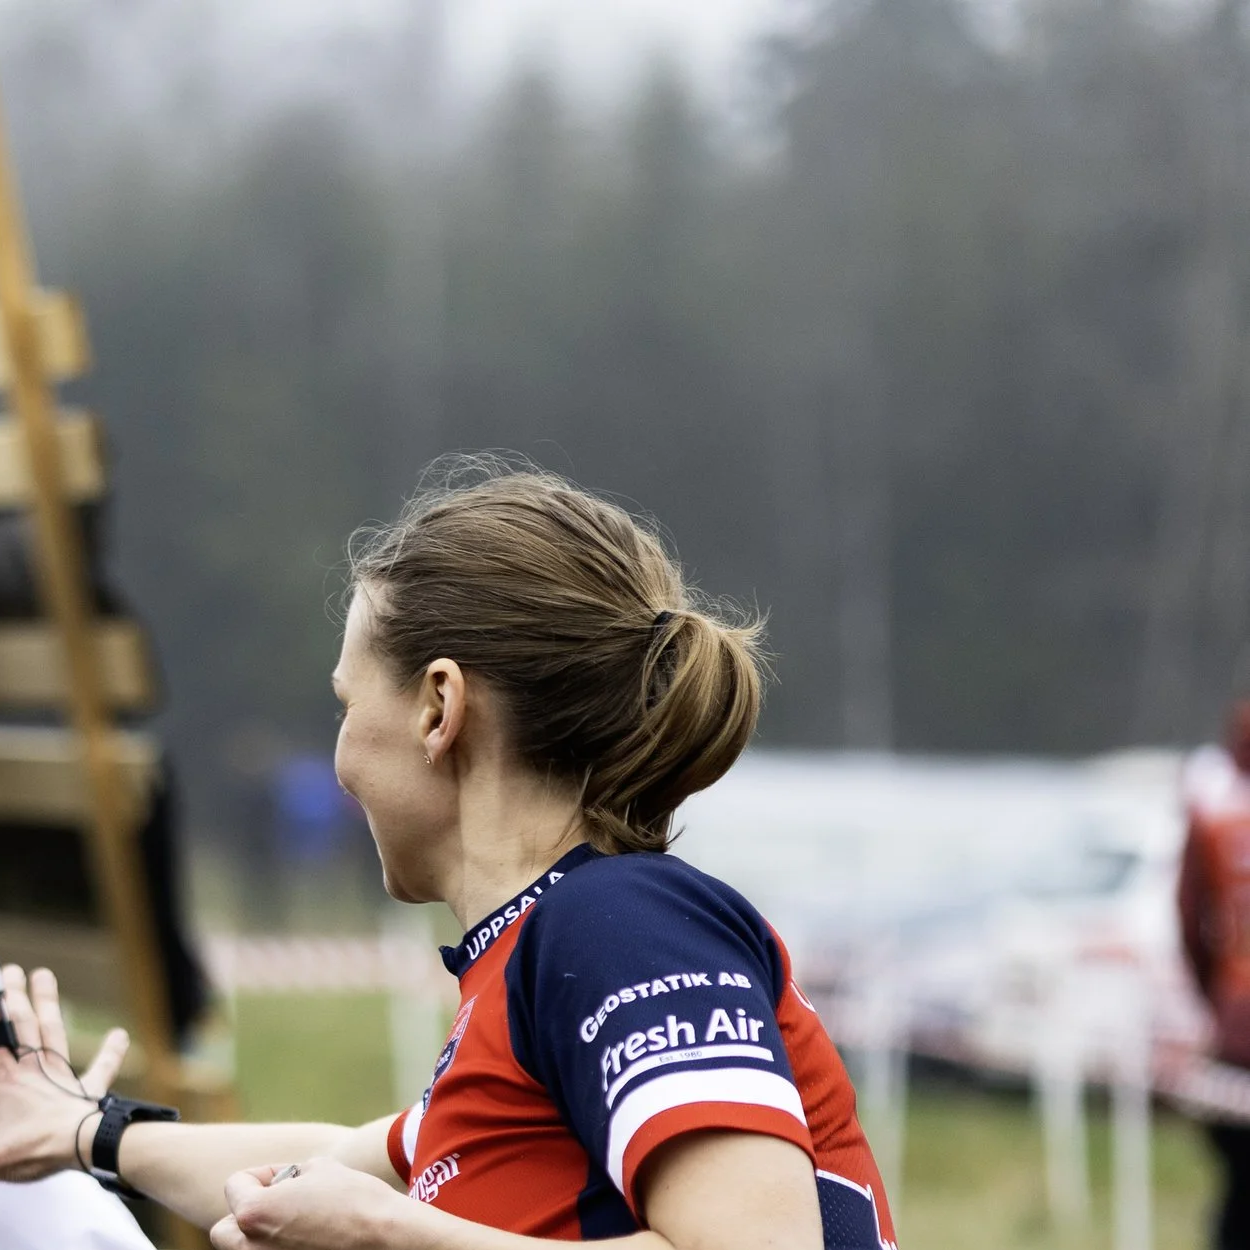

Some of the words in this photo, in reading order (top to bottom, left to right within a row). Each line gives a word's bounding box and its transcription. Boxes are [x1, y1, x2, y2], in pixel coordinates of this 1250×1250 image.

[580, 973, 713, 1043] GEOSTATIK
[718, 972, 752, 988] AB
[705, 1008, 764, 1042] Air
